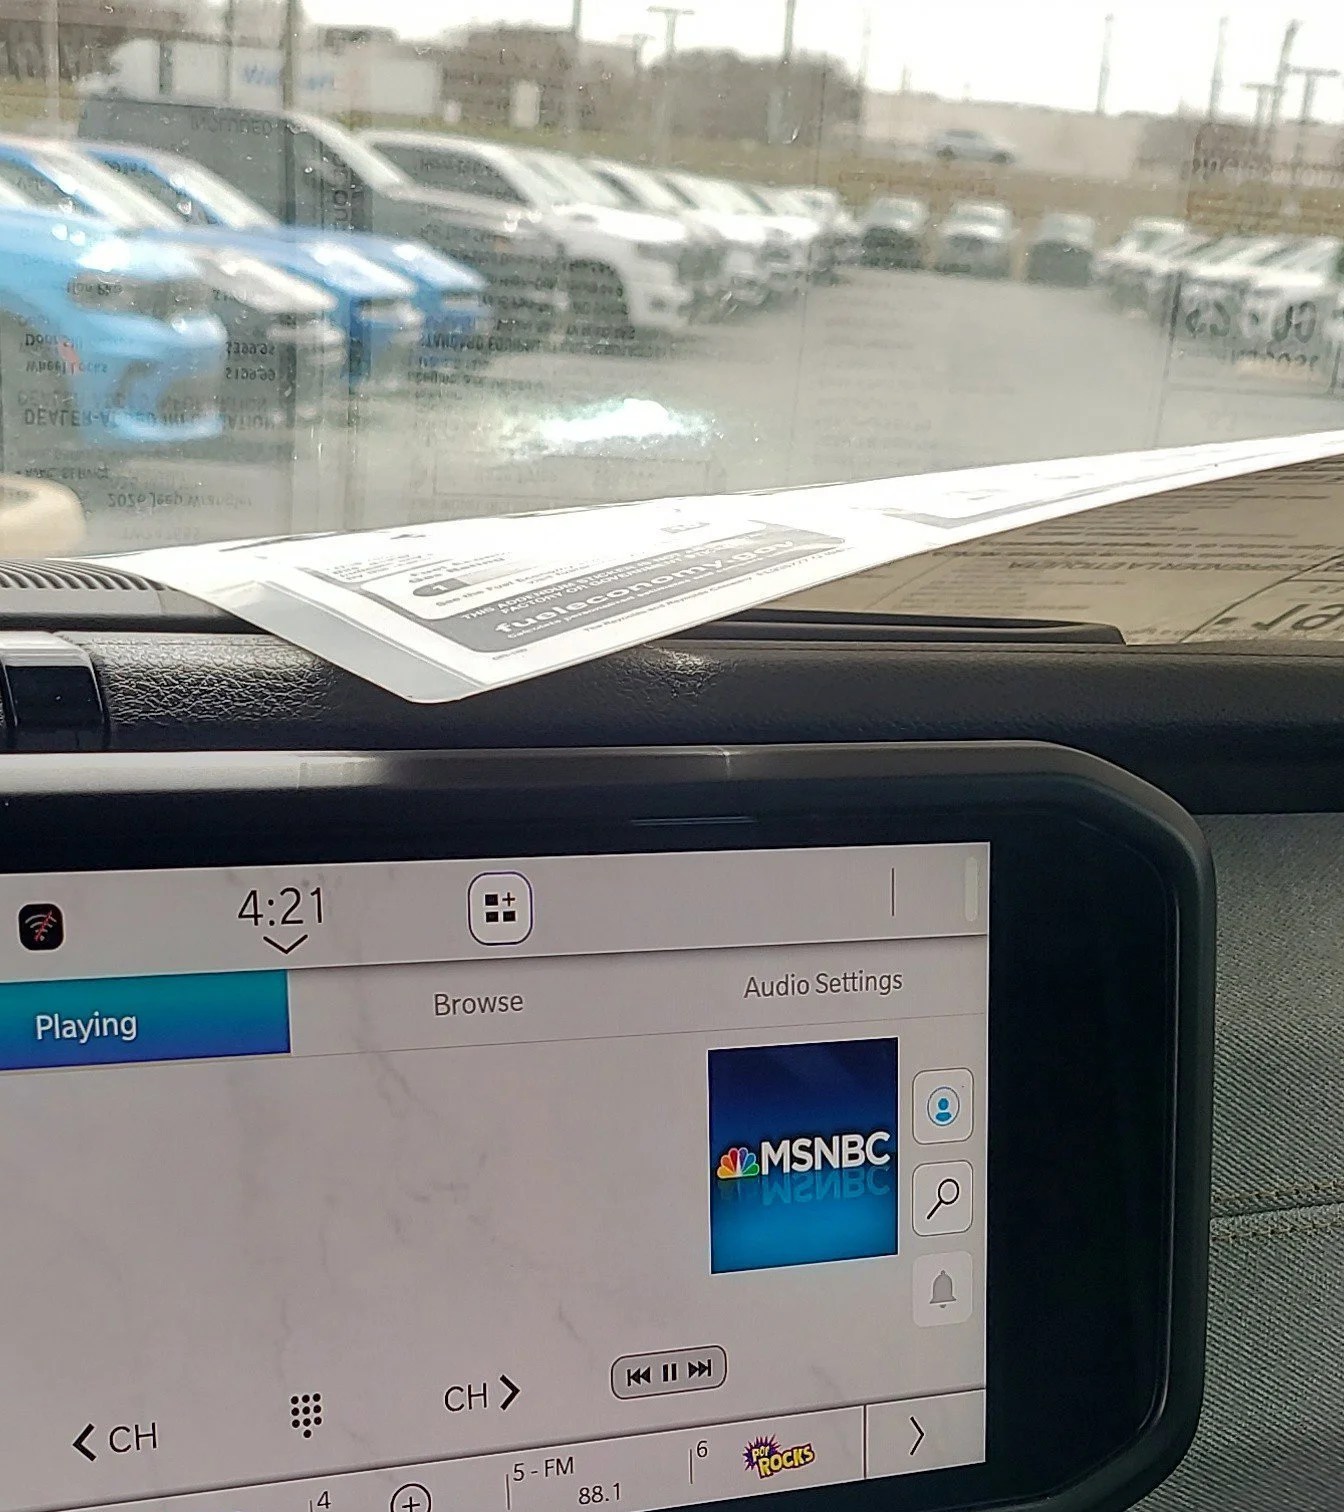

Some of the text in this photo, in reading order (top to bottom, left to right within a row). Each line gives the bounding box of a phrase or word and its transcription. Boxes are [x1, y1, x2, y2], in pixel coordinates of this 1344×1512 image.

[495, 540, 795, 633] fueleconomy.gov
[237, 886, 324, 927] 4:21
[744, 969, 903, 999] Audio Settings
[433, 992, 523, 1017] Browse
[35, 1011, 138, 1043] Playing
[760, 1130, 891, 1176] MSNBC
[444, 1383, 488, 1412] CH
[109, 1422, 159, 1454] CH
[696, 1440, 708, 1459] 6
[544, 1457, 575, 1478] FM
[757, 1444, 815, 1478] ROCKS
[316, 1490, 331, 1510] 4
[578, 1483, 622, 1506] 88.1
